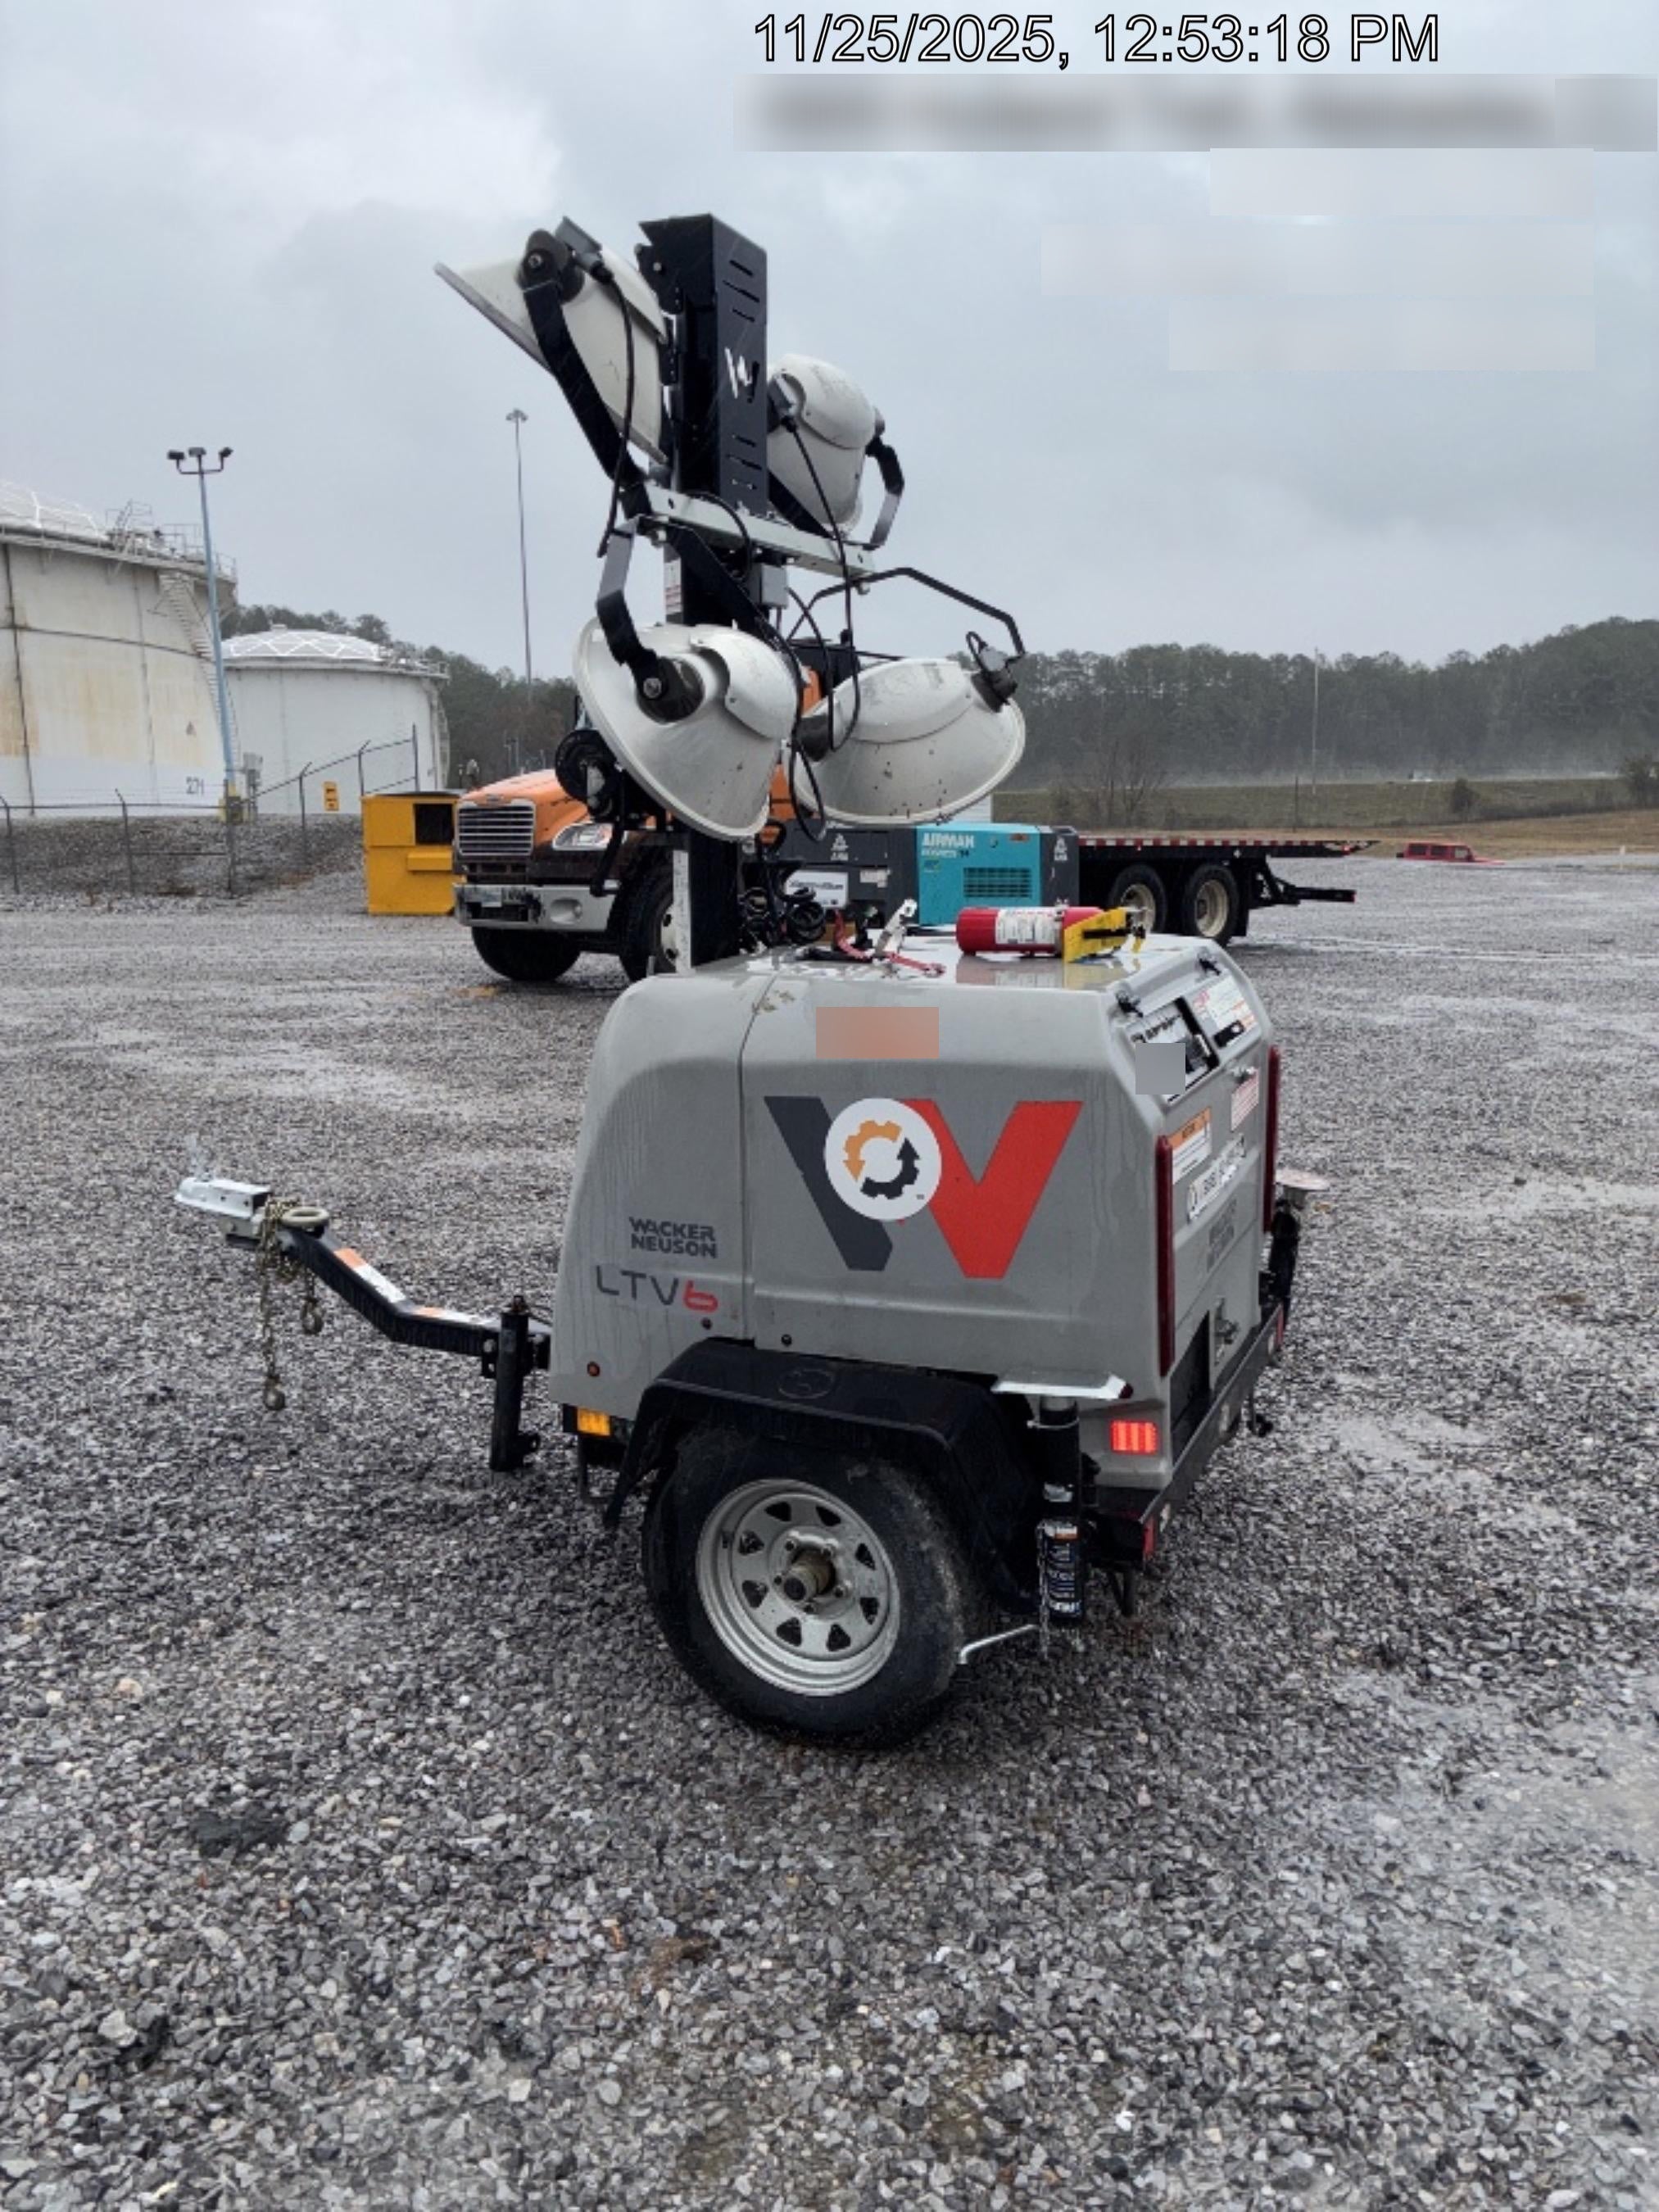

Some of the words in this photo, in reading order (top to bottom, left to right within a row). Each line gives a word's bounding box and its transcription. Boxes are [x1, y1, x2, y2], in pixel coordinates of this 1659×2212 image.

[628, 1216, 717, 1242] WACKER
[631, 1233, 718, 1259] NEUSON
[596, 1265, 719, 1313] LTV6
